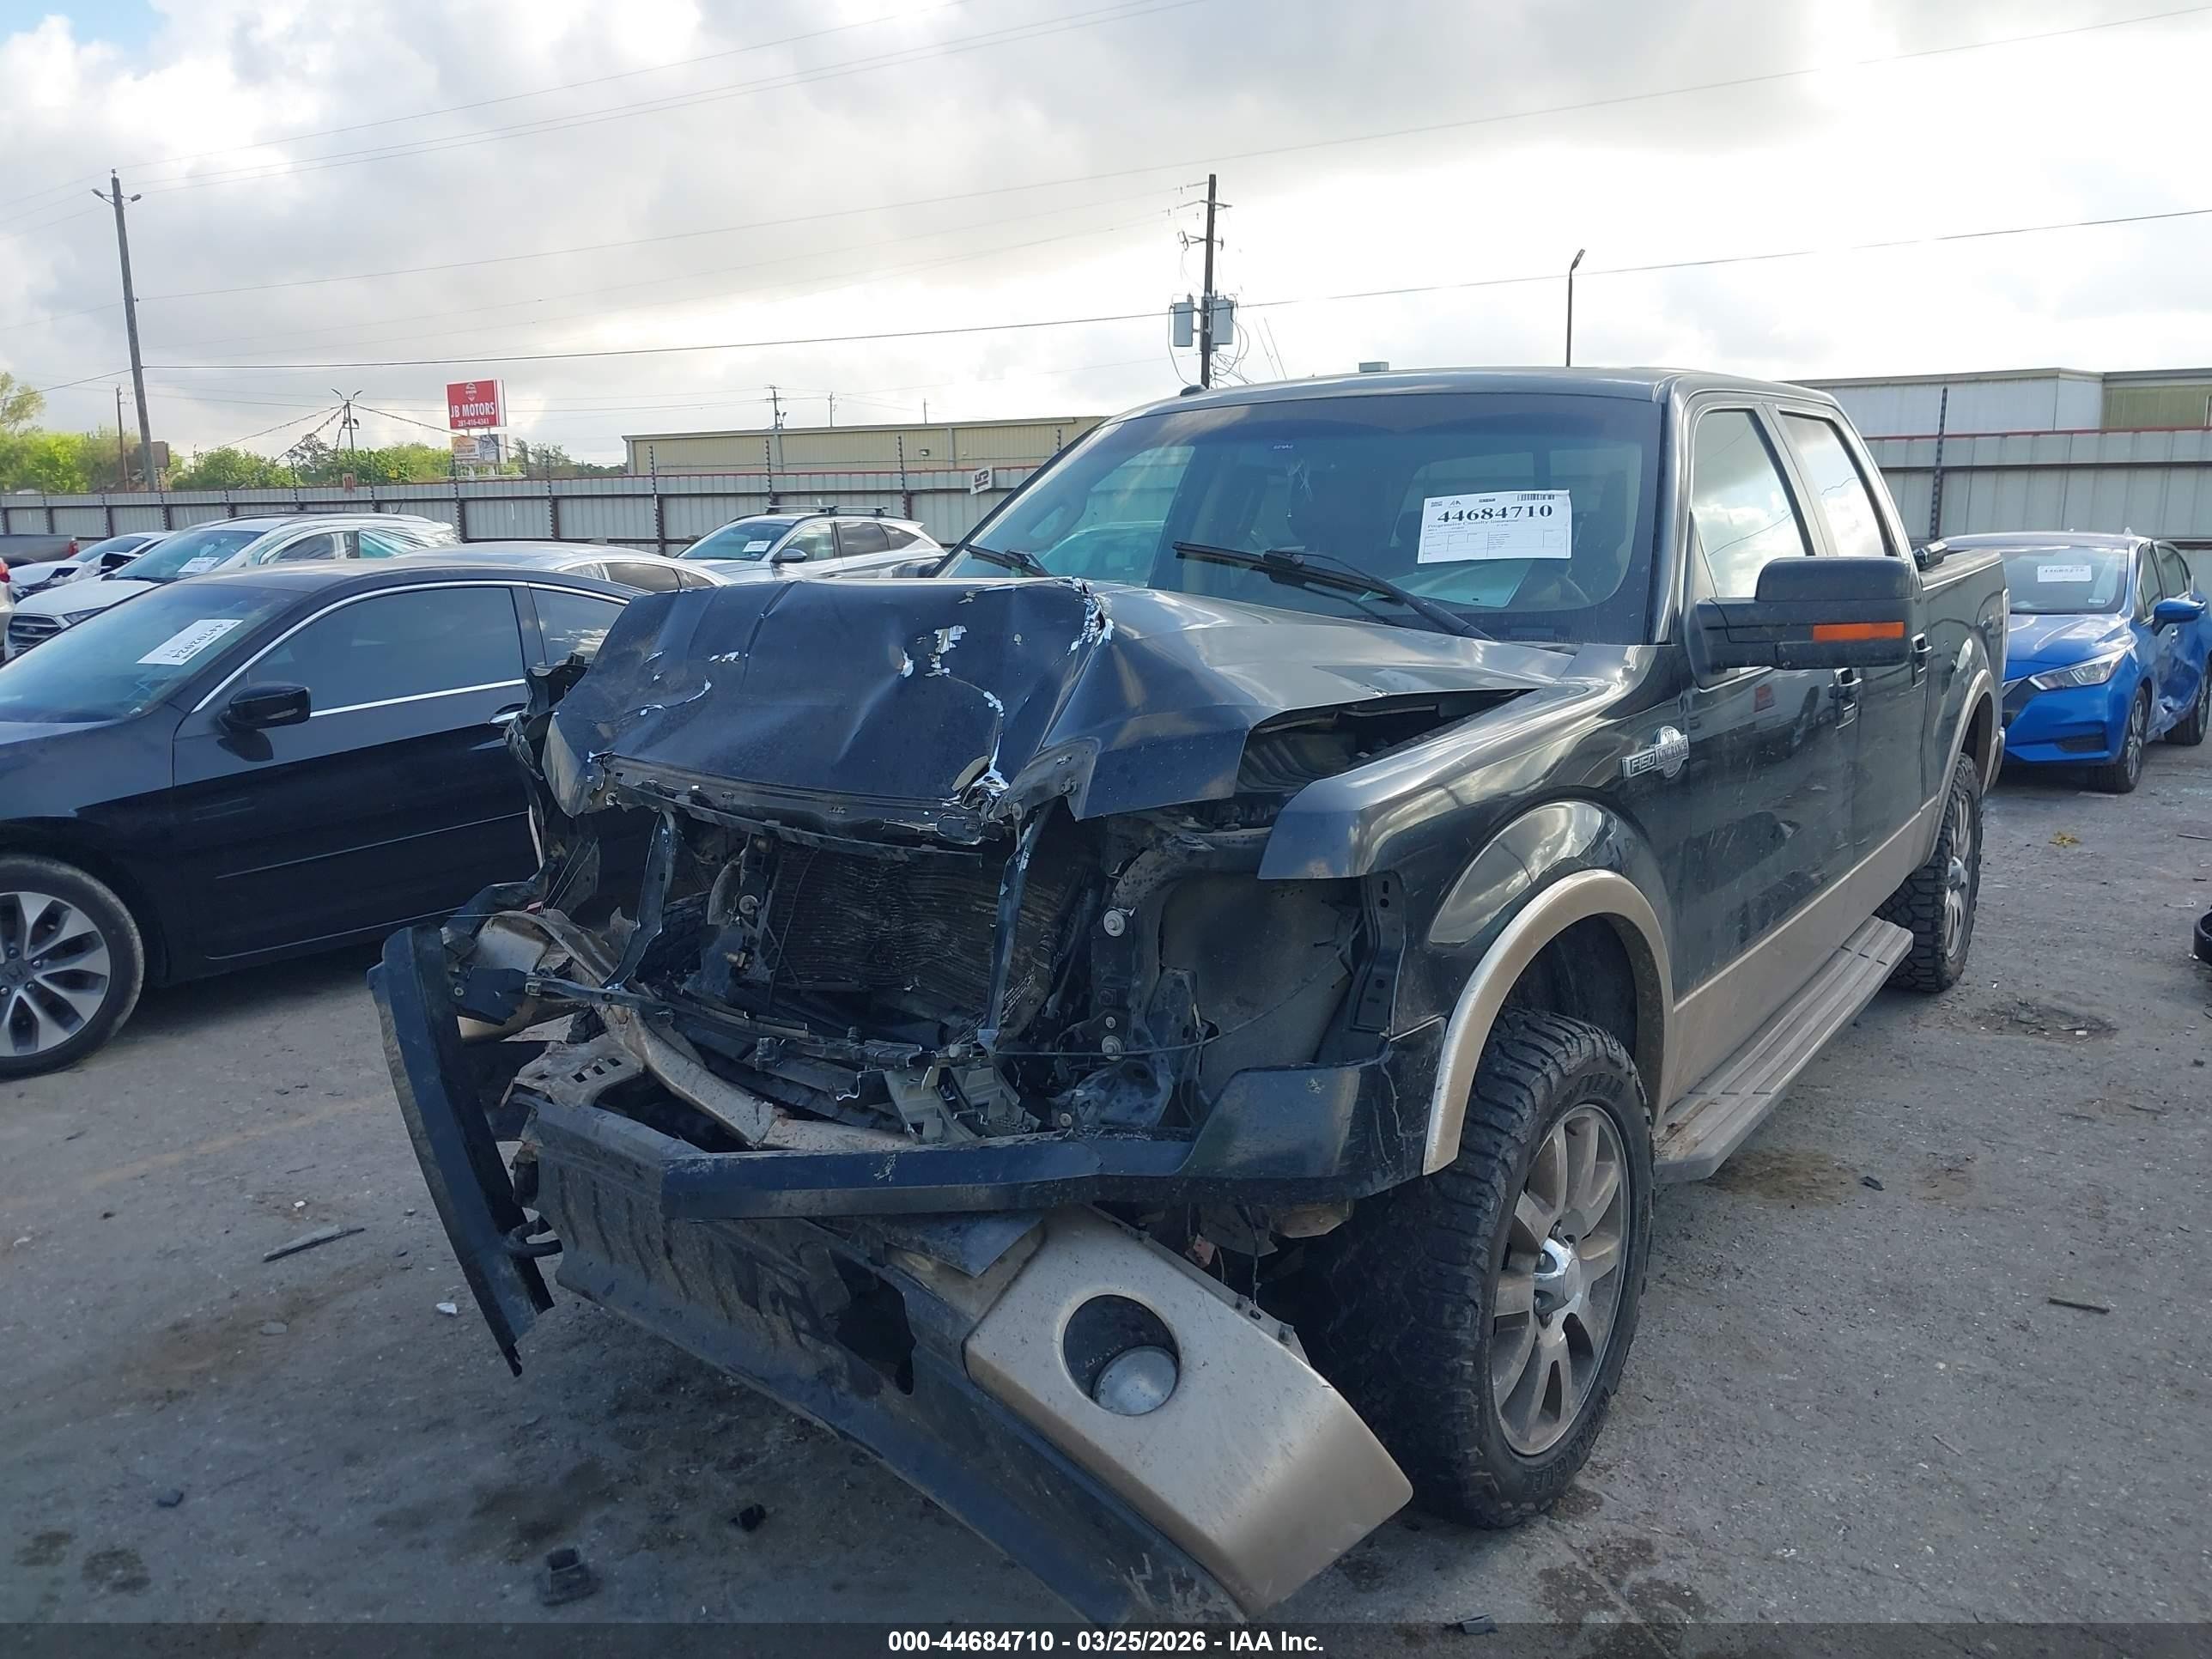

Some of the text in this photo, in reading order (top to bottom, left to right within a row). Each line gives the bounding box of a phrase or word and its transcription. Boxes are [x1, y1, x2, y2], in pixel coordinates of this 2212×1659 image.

[451, 402, 495, 418] JB MOTORS
[975, 470, 989, 490] 15
[1437, 504, 1553, 523] 44684710
